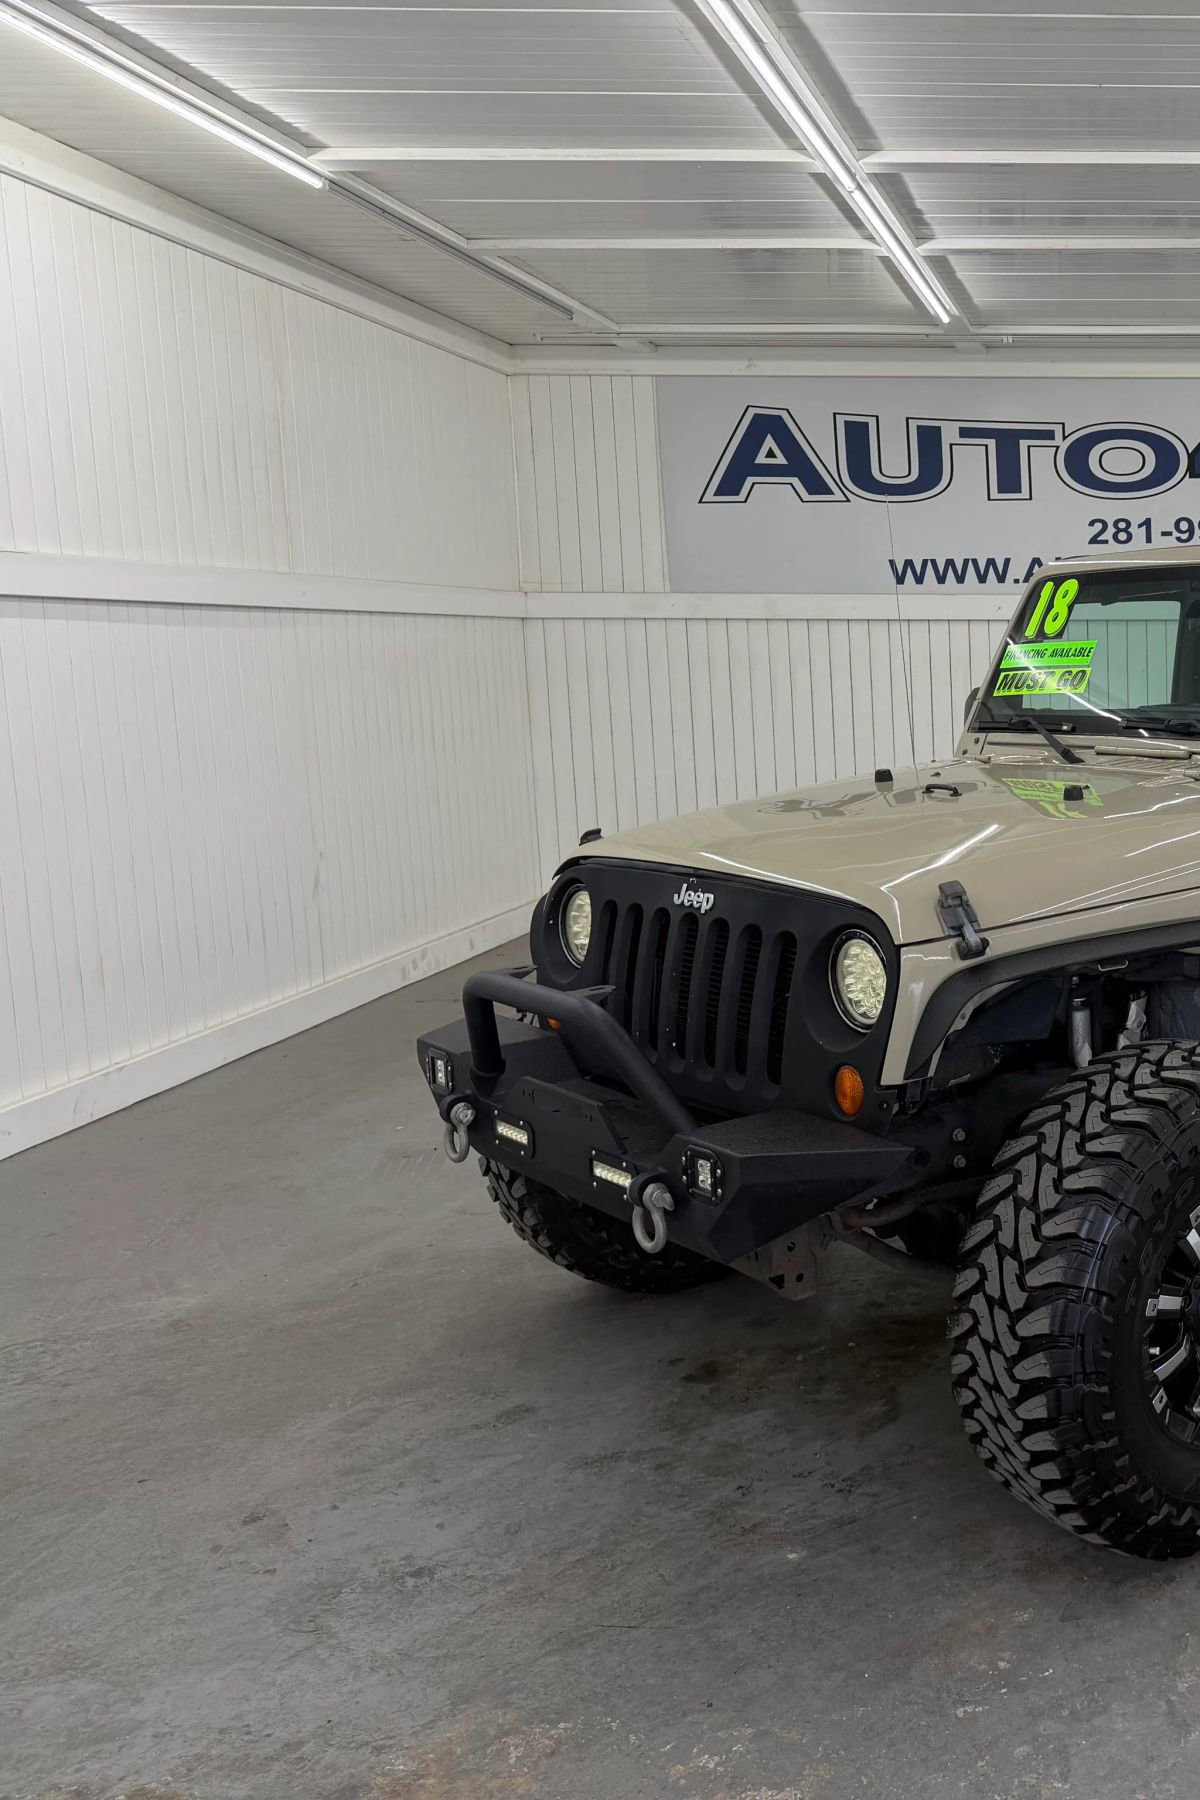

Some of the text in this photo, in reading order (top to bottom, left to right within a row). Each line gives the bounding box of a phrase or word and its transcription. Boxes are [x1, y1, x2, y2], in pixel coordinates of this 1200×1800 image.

[888, 557, 1062, 585] WWW.A
[1025, 579, 1080, 638] 18
[1048, 646, 1094, 659] AVAILABLE
[996, 669, 1088, 692] MUST GO
[673, 883, 714, 914] Jeep
